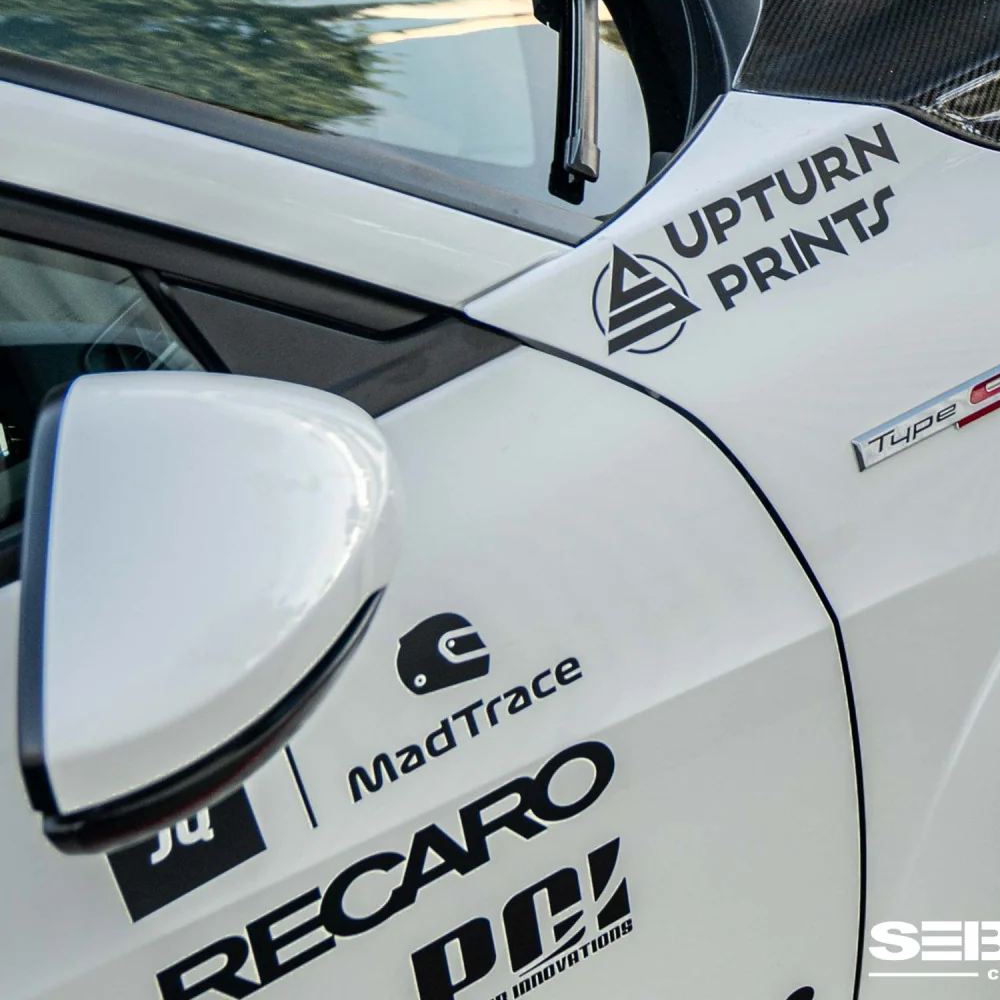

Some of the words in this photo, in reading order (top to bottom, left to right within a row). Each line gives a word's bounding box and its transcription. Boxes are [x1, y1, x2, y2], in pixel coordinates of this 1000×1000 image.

[663, 123, 899, 258] UPTURN
[707, 185, 895, 311] PRINTS
[868, 403, 957, 453] Type
[348, 656, 582, 802] MadTrace
[156, 740, 615, 1000] RECARO
[512, 918, 634, 999] INNOVATIONS
